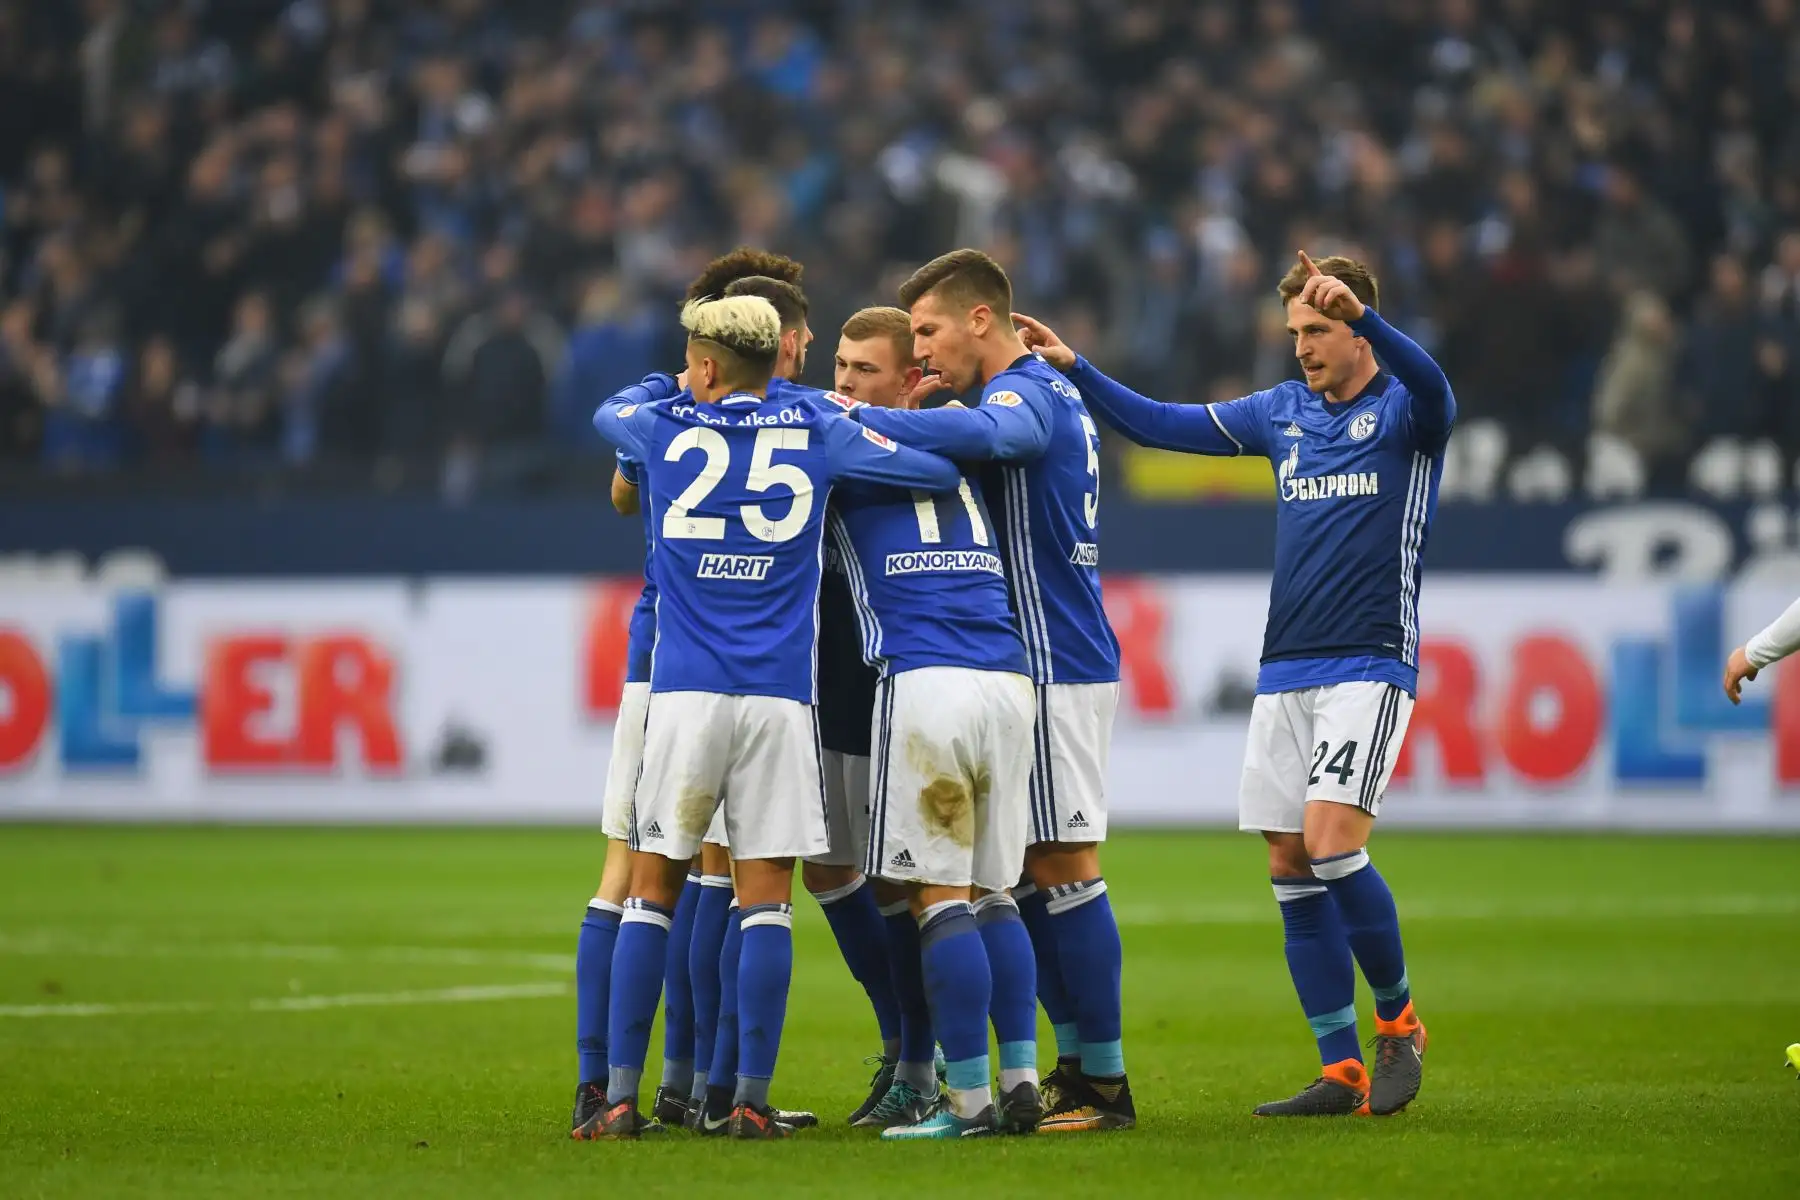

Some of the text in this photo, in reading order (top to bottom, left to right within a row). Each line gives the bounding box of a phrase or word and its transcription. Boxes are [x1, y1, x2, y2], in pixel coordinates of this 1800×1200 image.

[780, 408, 804, 424] 04
[663, 426, 813, 543] 25
[1080, 413, 1099, 530] 5
[1298, 472, 1378, 500] GAZPROM
[697, 554, 774, 580] HARIT
[1394, 585, 1800, 788] ROLL
[1307, 740, 1358, 786] 24
[646, 831, 665, 839] adidas
[890, 859, 916, 868] adidas
